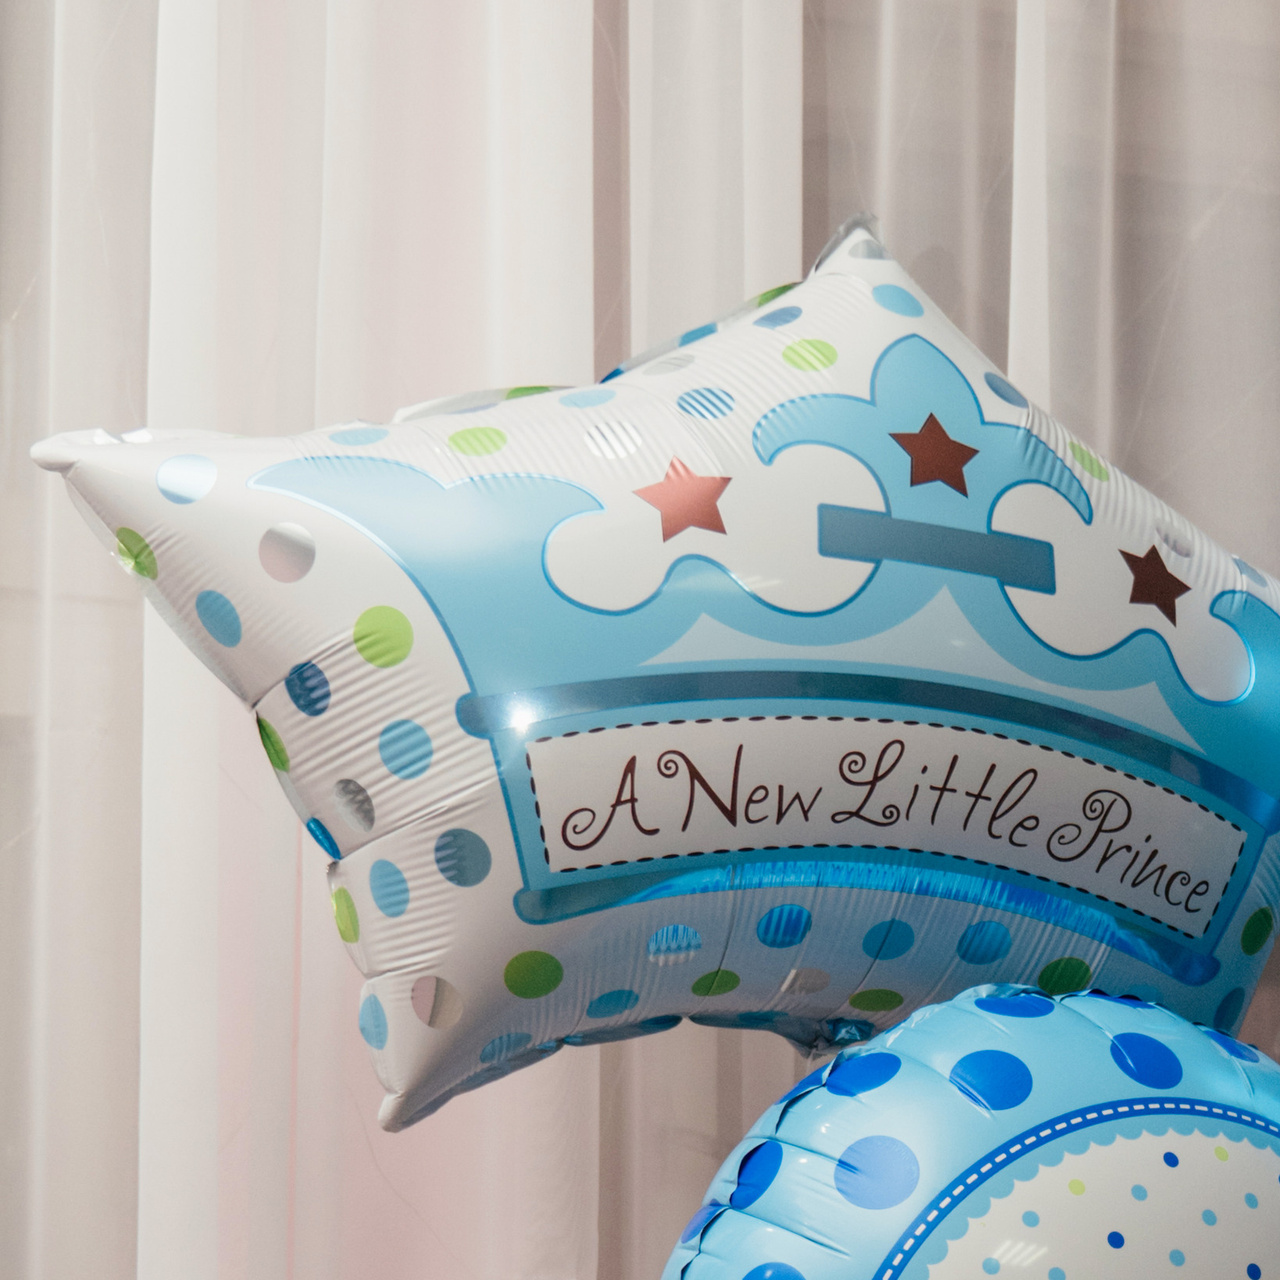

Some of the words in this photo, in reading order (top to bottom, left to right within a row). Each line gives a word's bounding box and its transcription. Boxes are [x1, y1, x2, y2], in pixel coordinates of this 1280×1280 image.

[561, 755, 660, 852] A
[656, 743, 823, 833] New
[830, 738, 1048, 849] Little
[1045, 787, 1213, 915] Prince
